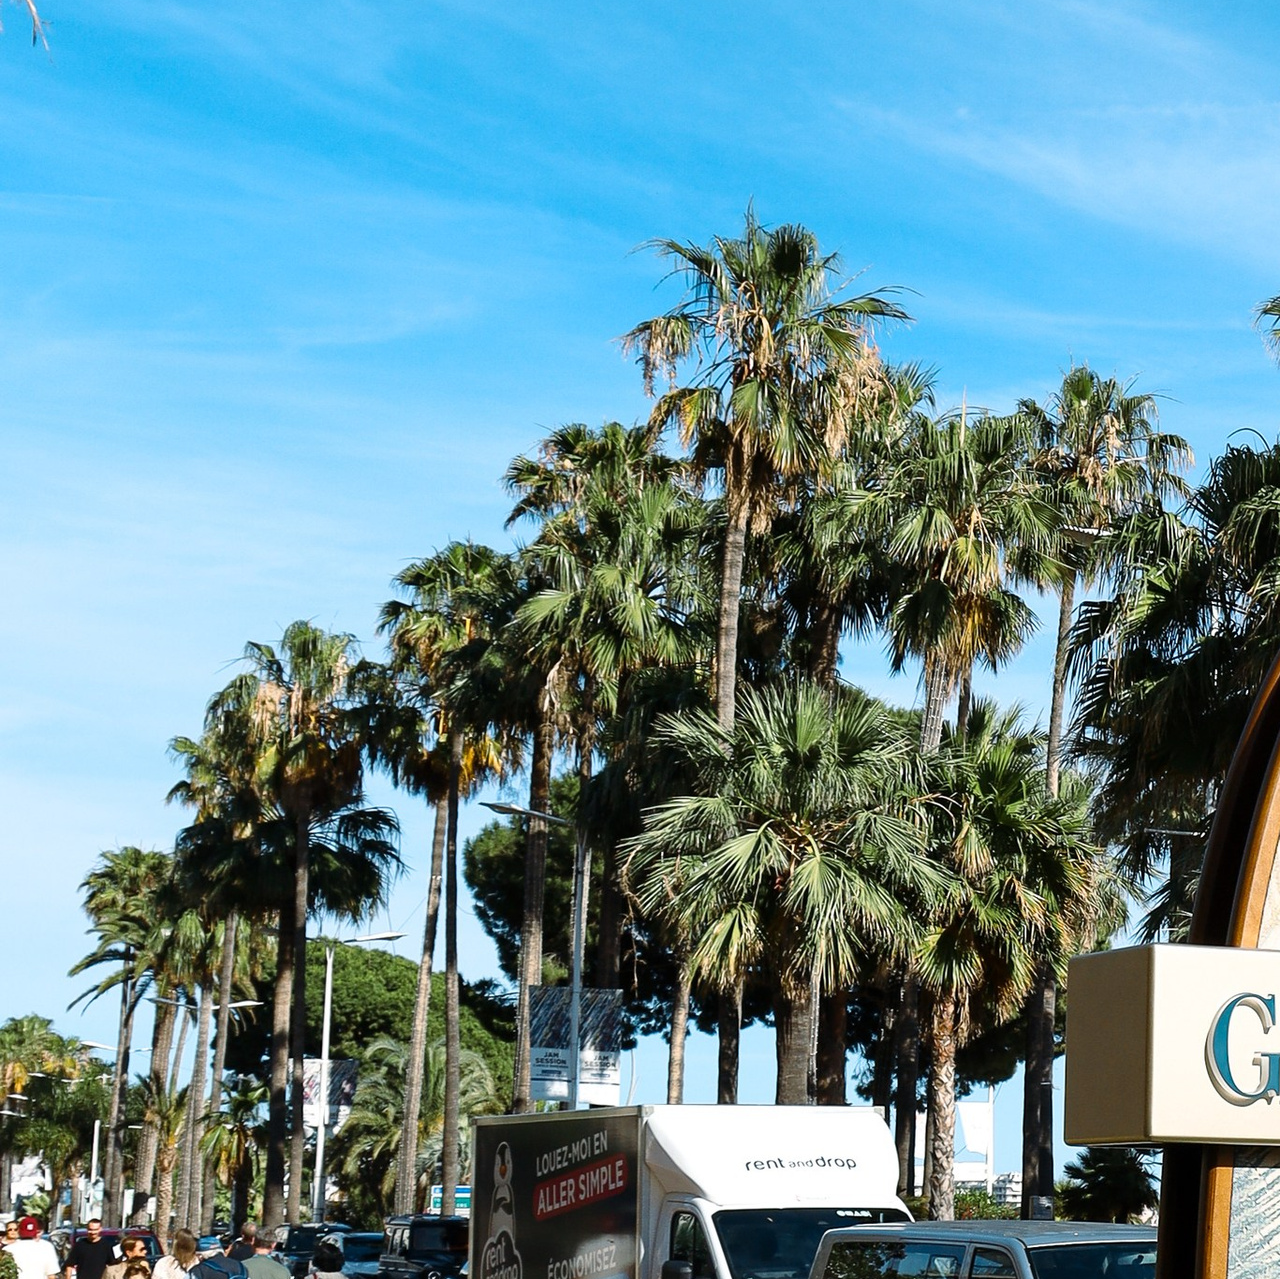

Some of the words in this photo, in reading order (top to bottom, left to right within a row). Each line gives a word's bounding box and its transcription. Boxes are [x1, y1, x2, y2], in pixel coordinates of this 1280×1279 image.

[535, 1057, 567, 1065] SESSION
[536, 1136, 591, 1177] LOUEZ-MOI
[594, 1129, 608, 1155] EN
[745, 1157, 786, 1171] rent
[537, 1178, 575, 1215] ALLER
[578, 1159, 624, 1200] SIMPLE
[486, 1237, 507, 1270] rent
